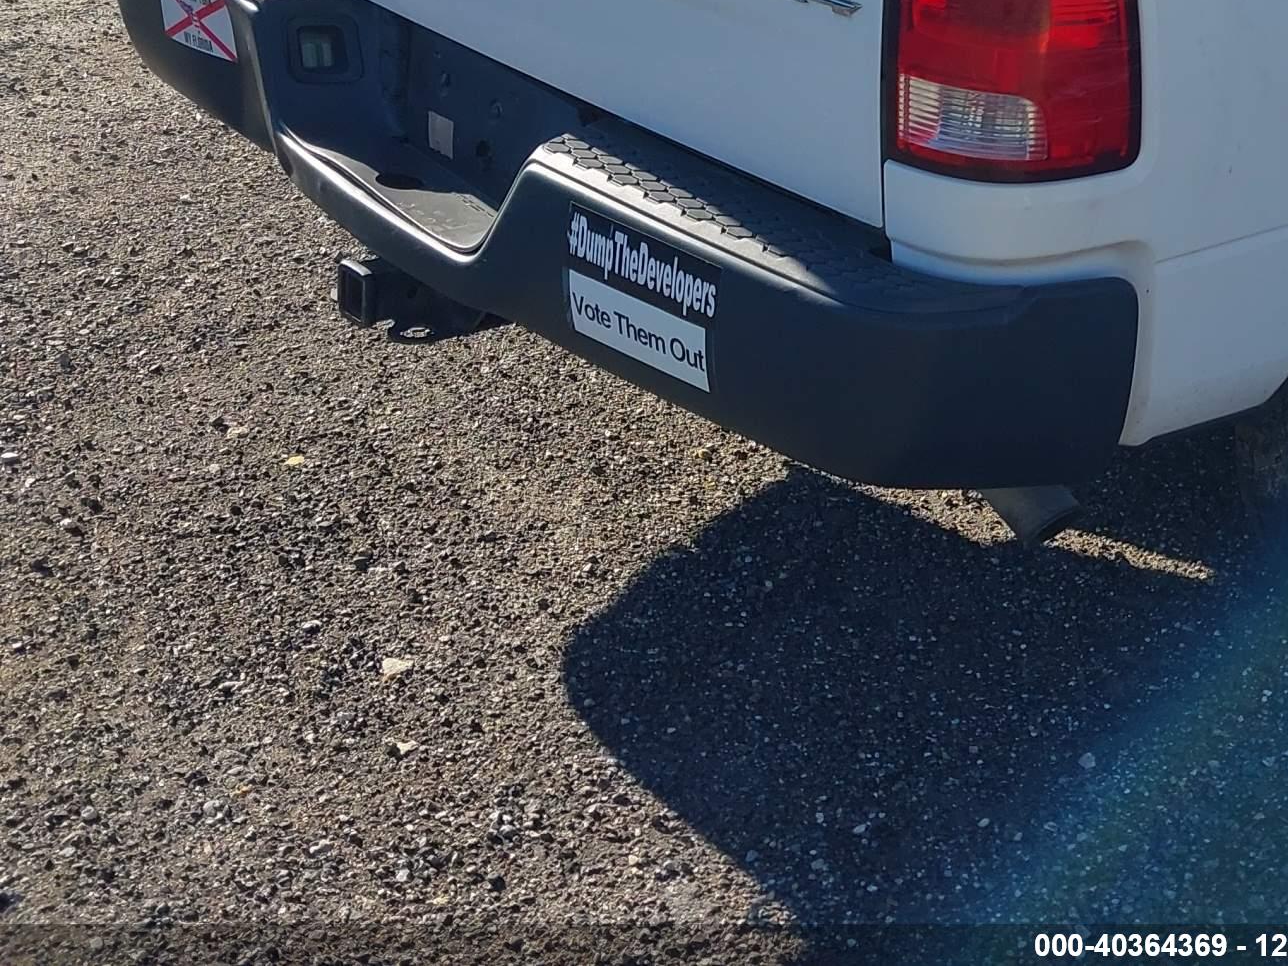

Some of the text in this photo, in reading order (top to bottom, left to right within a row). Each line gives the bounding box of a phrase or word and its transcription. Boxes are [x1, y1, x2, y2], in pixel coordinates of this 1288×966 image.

[568, 211, 717, 318] #DumpTheDevelopers
[571, 291, 706, 373] Vote Them Out
